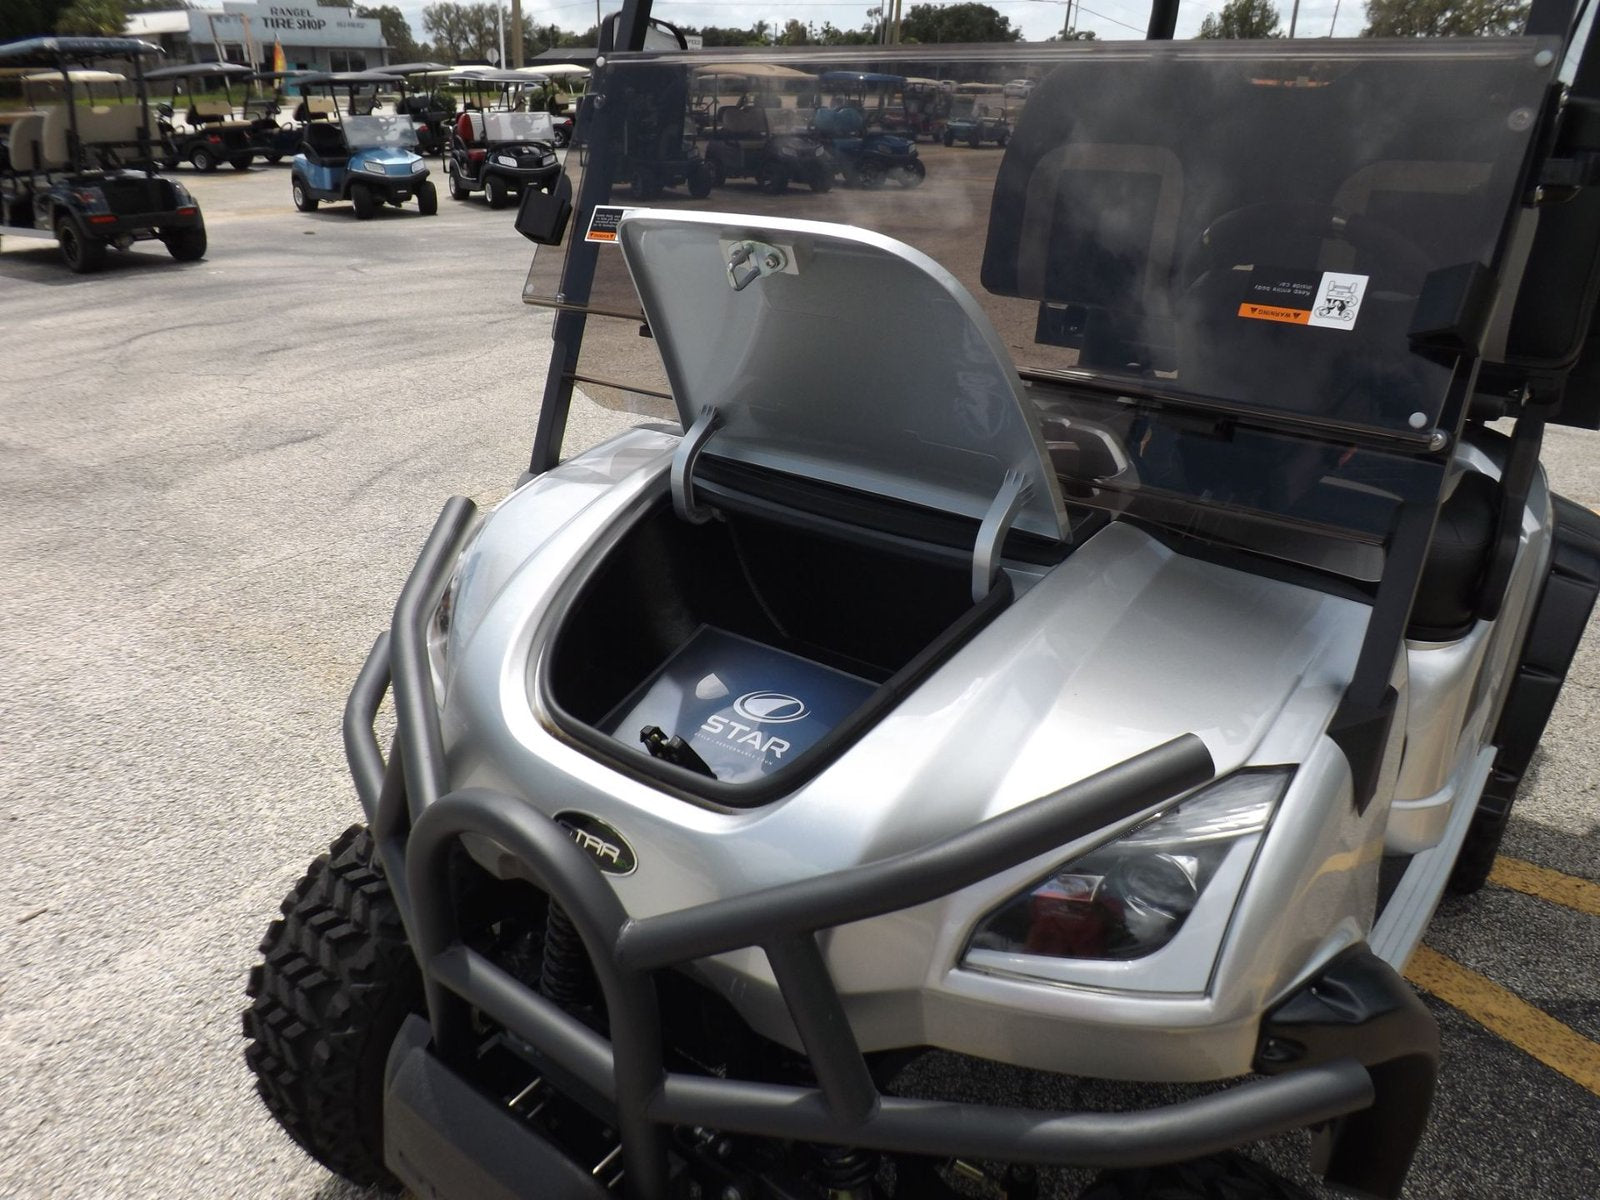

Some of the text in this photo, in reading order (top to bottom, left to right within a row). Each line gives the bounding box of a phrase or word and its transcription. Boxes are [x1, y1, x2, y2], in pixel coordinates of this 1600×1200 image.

[270, 7, 314, 17] RANGEL
[262, 17, 295, 29] TIRE
[297, 18, 326, 30] SHOP
[1254, 284, 1311, 296] Keep entire body
[1293, 282, 1312, 290] inside
[1258, 308, 1293, 318] WARNING
[700, 714, 791, 759] STAR
